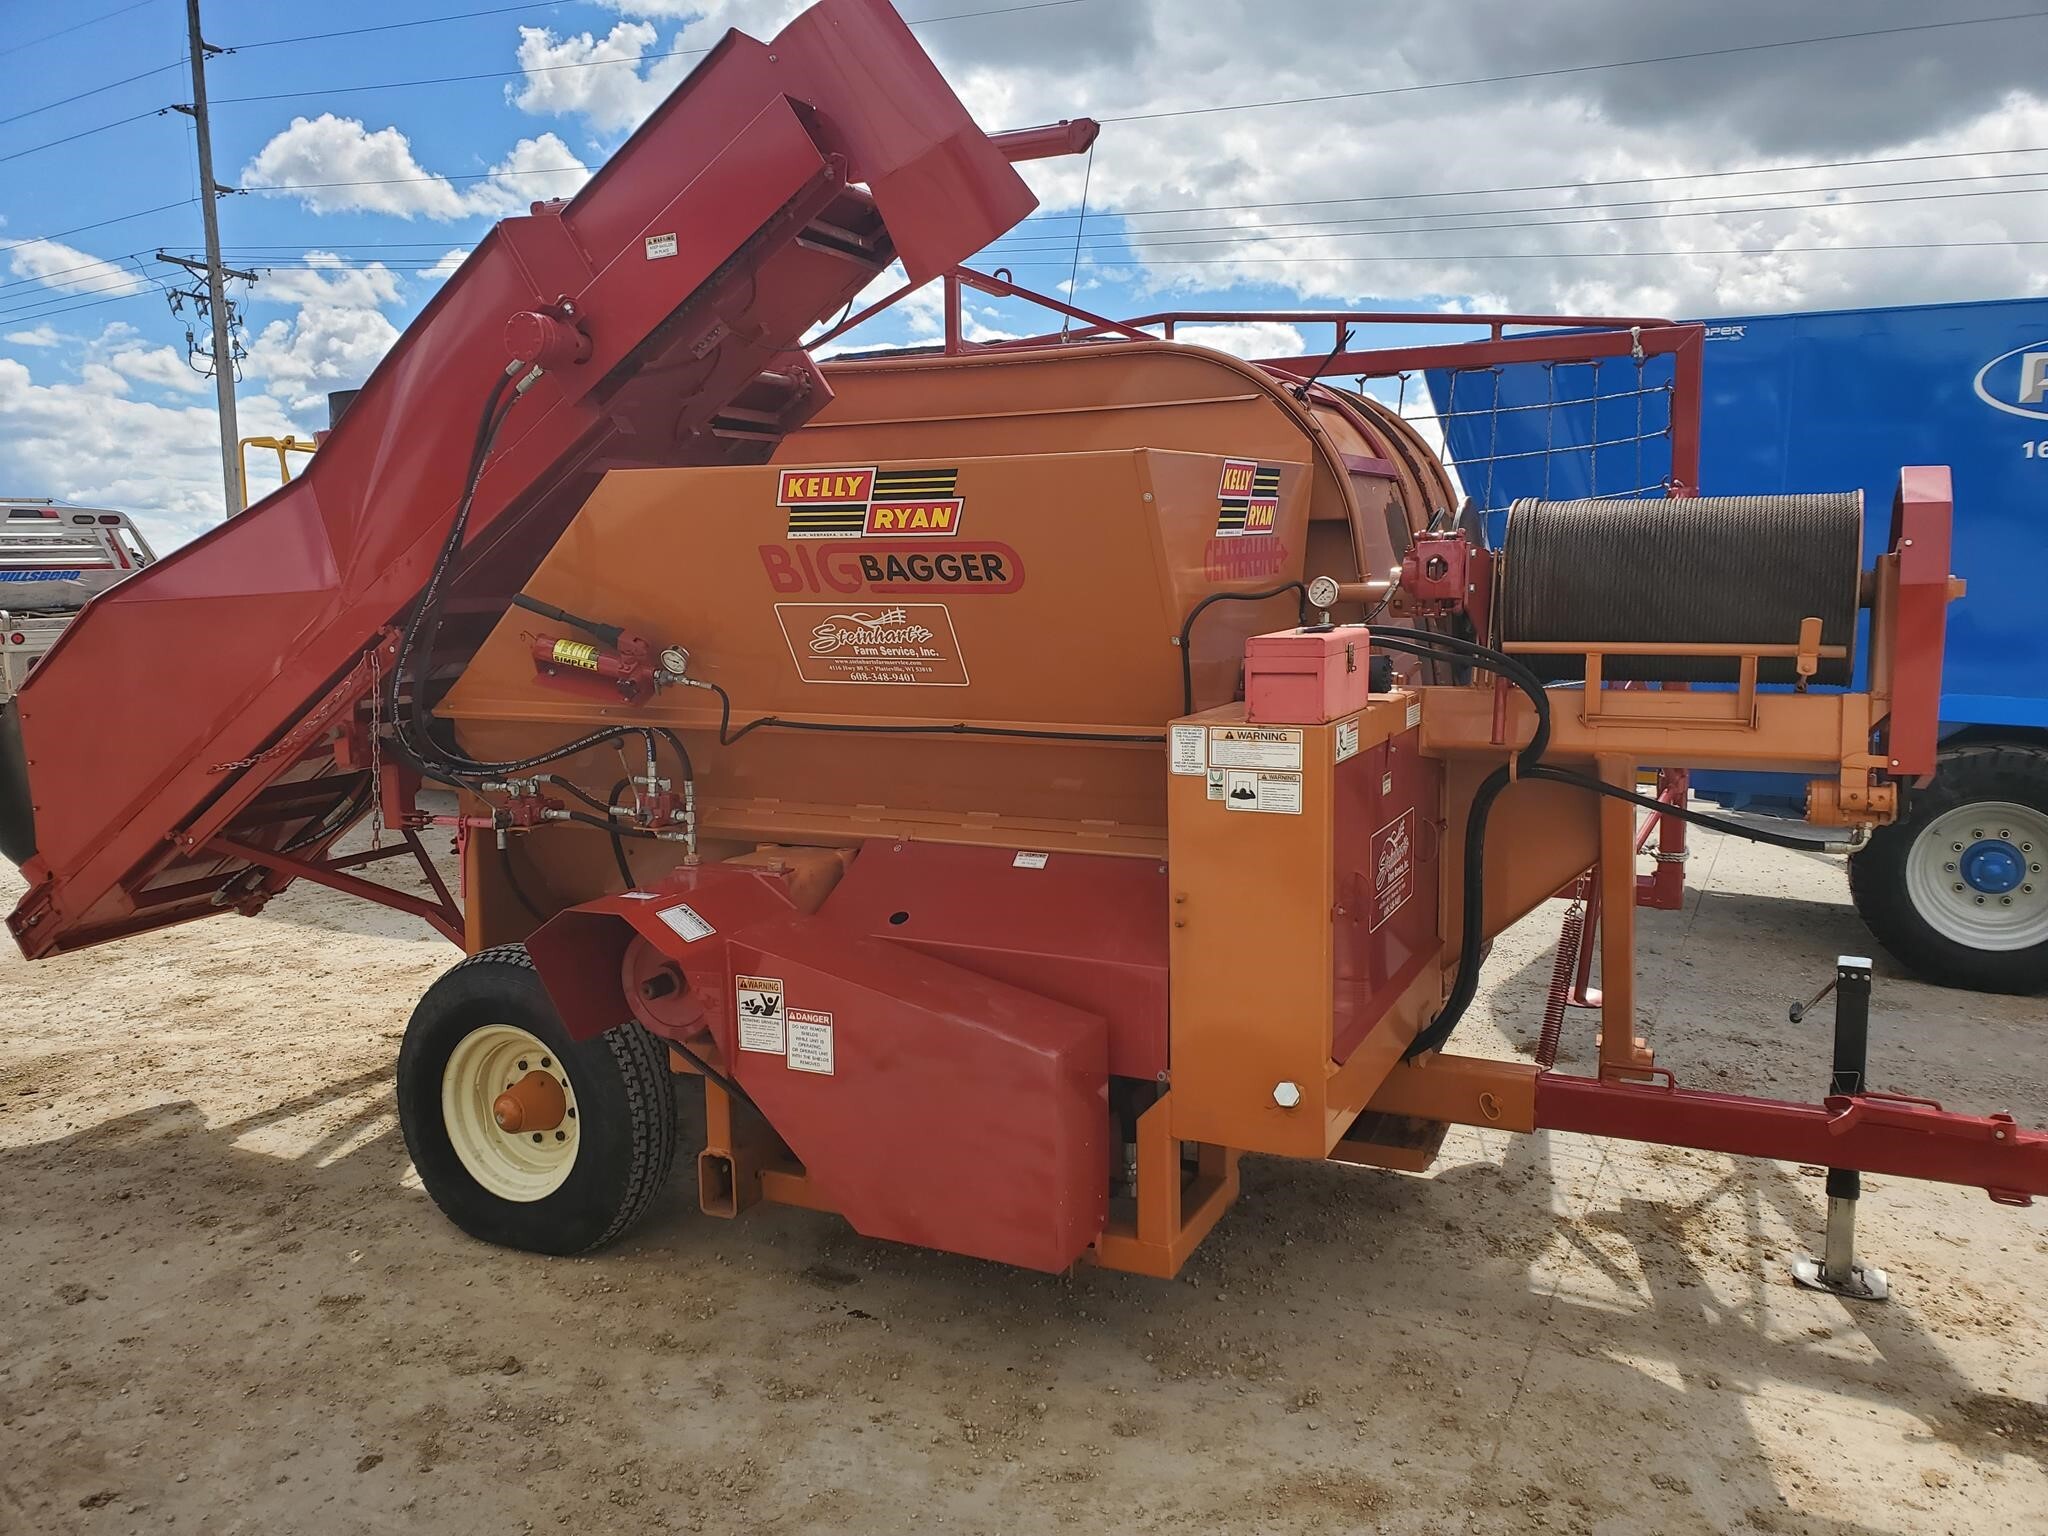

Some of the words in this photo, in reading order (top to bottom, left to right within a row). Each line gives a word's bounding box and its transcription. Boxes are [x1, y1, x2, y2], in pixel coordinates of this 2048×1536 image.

[787, 477, 864, 498] KELLY
[1223, 468, 1253, 491] KELLY
[874, 506, 952, 529] RYAN
[1247, 505, 1275, 526] RYAN
[759, 543, 863, 593] BIG
[859, 554, 1006, 582] BAGGER
[809, 624, 933, 653] Steinhart's
[854, 646, 879, 656] Farm
[880, 646, 919, 657] Service,
[921, 647, 939, 657] Inc.
[554, 655, 596, 669] SIMPLEX
[850, 672, 916, 682] 608-348-9401
[1237, 731, 1287, 741] WARNING
[747, 981, 779, 991] WARNING
[796, 1012, 830, 1024] DANGER
